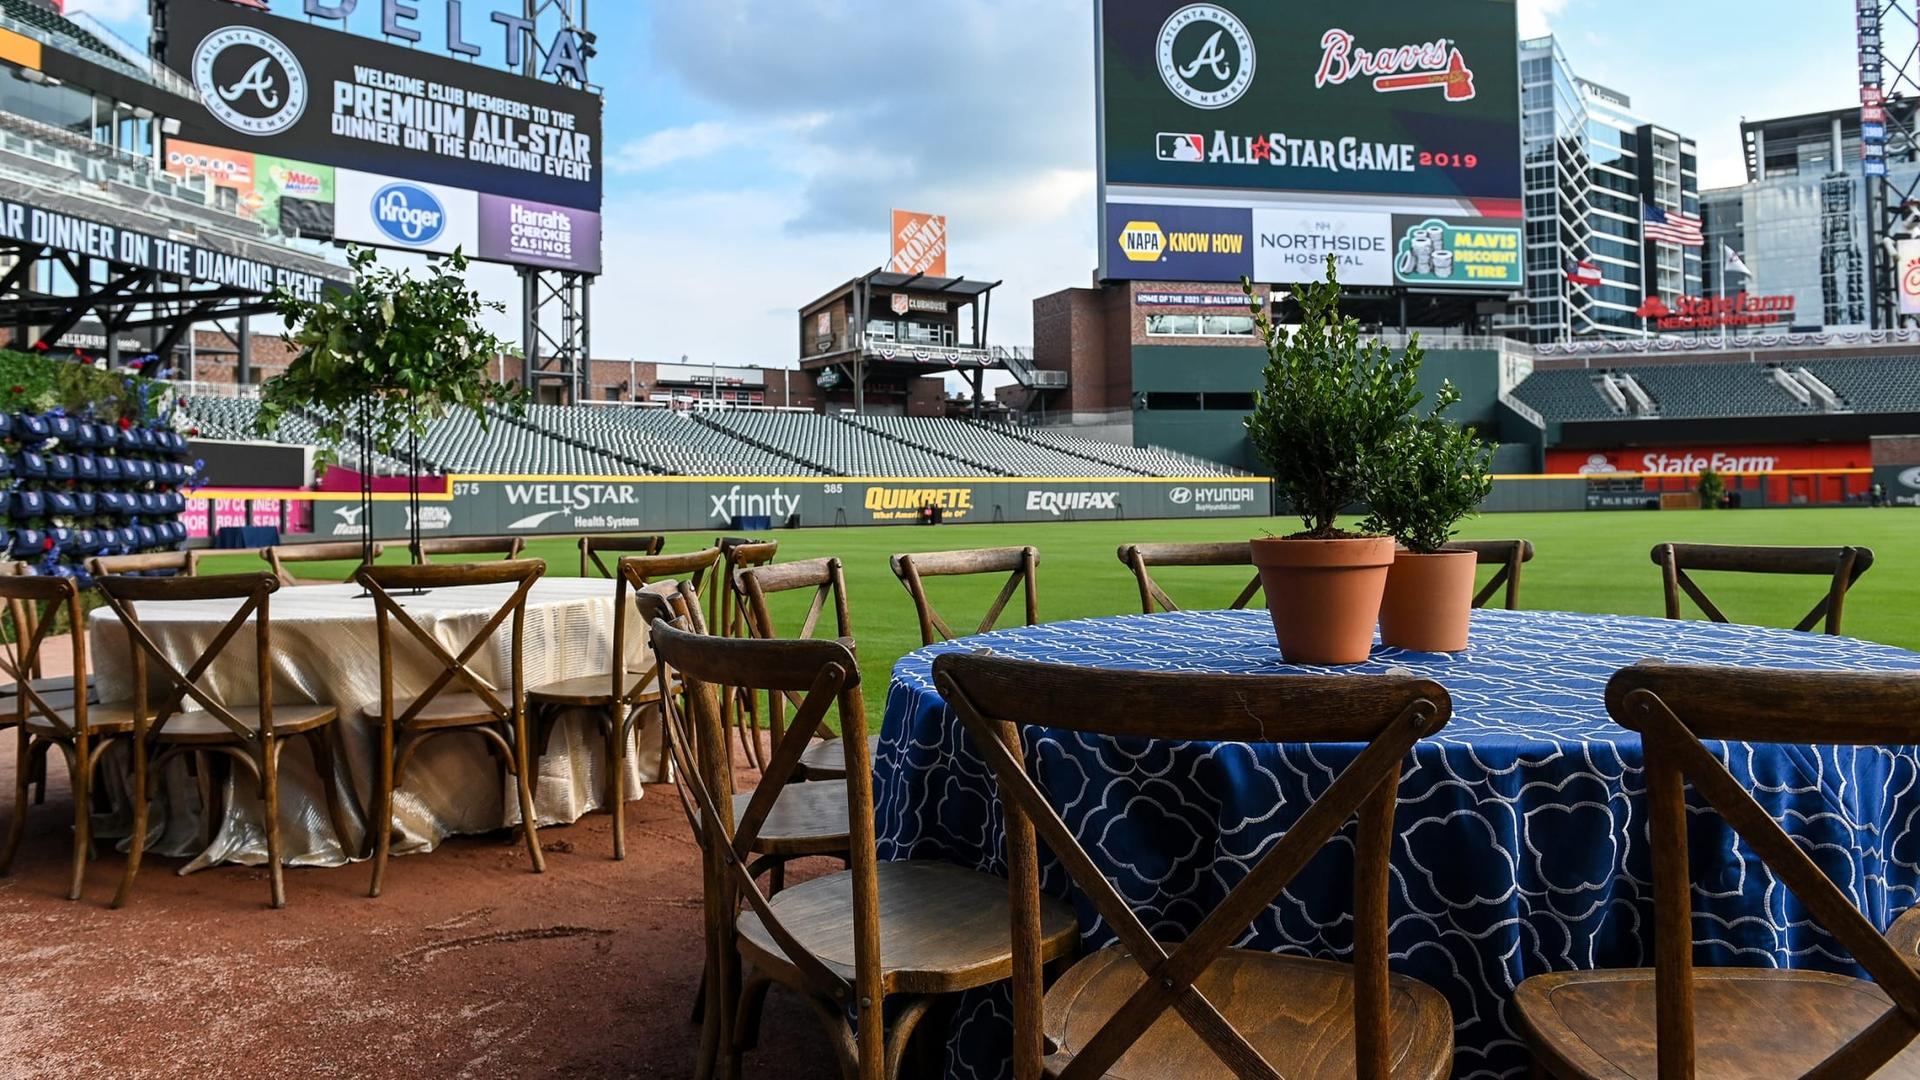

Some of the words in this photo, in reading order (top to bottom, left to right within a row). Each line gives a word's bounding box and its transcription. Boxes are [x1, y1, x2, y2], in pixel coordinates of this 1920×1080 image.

[1164, 10, 1205, 46] ATLANTA
[1212, 12, 1248, 50] BRAVES
[202, 33, 251, 64] ATLANTA
[258, 38, 299, 81] BRAVES
[1315, 28, 1447, 88] Braves
[1165, 64, 1191, 96] CLUB
[1200, 70, 1247, 102] MEMBER
[202, 82, 232, 118] CLUB
[243, 101, 298, 129] MEMBER
[354, 65, 425, 98] WELCOME
[428, 82, 464, 105] CLUB
[467, 91, 530, 120] MEMBERS
[532, 105, 549, 124] TO
[551, 110, 575, 130] THE
[334, 80, 465, 138] PREMIUM
[473, 112, 591, 164] ALL-STAR
[331, 112, 400, 146] DINNER
[404, 129, 429, 151] ON
[432, 134, 465, 158] THE
[469, 140, 542, 173] DIAMOND
[544, 158, 592, 182] EVENT
[1419, 152, 1477, 168] 2019
[379, 191, 440, 239] Kroger
[511, 203, 572, 229] Harrah's
[511, 225, 572, 243] CHEROKEE
[898, 218, 921, 243] THE
[1261, 233, 1386, 251] NORTHSIDE
[1455, 233, 1516, 249] MAVIS
[511, 238, 572, 254] CASINOS
[893, 215, 945, 273] HOME
[1127, 232, 1159, 251] NAPA
[1169, 233, 1209, 253] KNOW
[1212, 234, 1243, 254] HOW
[31, 208, 114, 257] DINNER
[121, 232, 150, 267] ON
[154, 239, 191, 277] THE
[196, 249, 272, 293] DIAMOND
[277, 273, 324, 303] EVENT
[914, 238, 945, 272] DEPOT
[1284, 253, 1363, 266] HOSPTAL
[1454, 250, 1517, 263] DISCOUNT
[1465, 265, 1508, 278] TIRE
[909, 299, 947, 311] CLUBHOUSE
[1137, 295, 1158, 303] HOME
[1159, 295, 1168, 303] OF
[1169, 295, 1182, 303] THE
[1184, 295, 1199, 304] 2021
[453, 483, 480, 495] 375
[505, 485, 635, 510] WELLSTAR
[823, 484, 843, 493] 385
[865, 487, 971, 510] QUIKRETE
[1195, 488, 1254, 501] HYUNDAI
[711, 485, 800, 524] xfinity
[1026, 491, 1115, 515] EQUIFAX
[574, 516, 604, 527] Health
[606, 516, 639, 529] System
[873, 511, 893, 519] What
